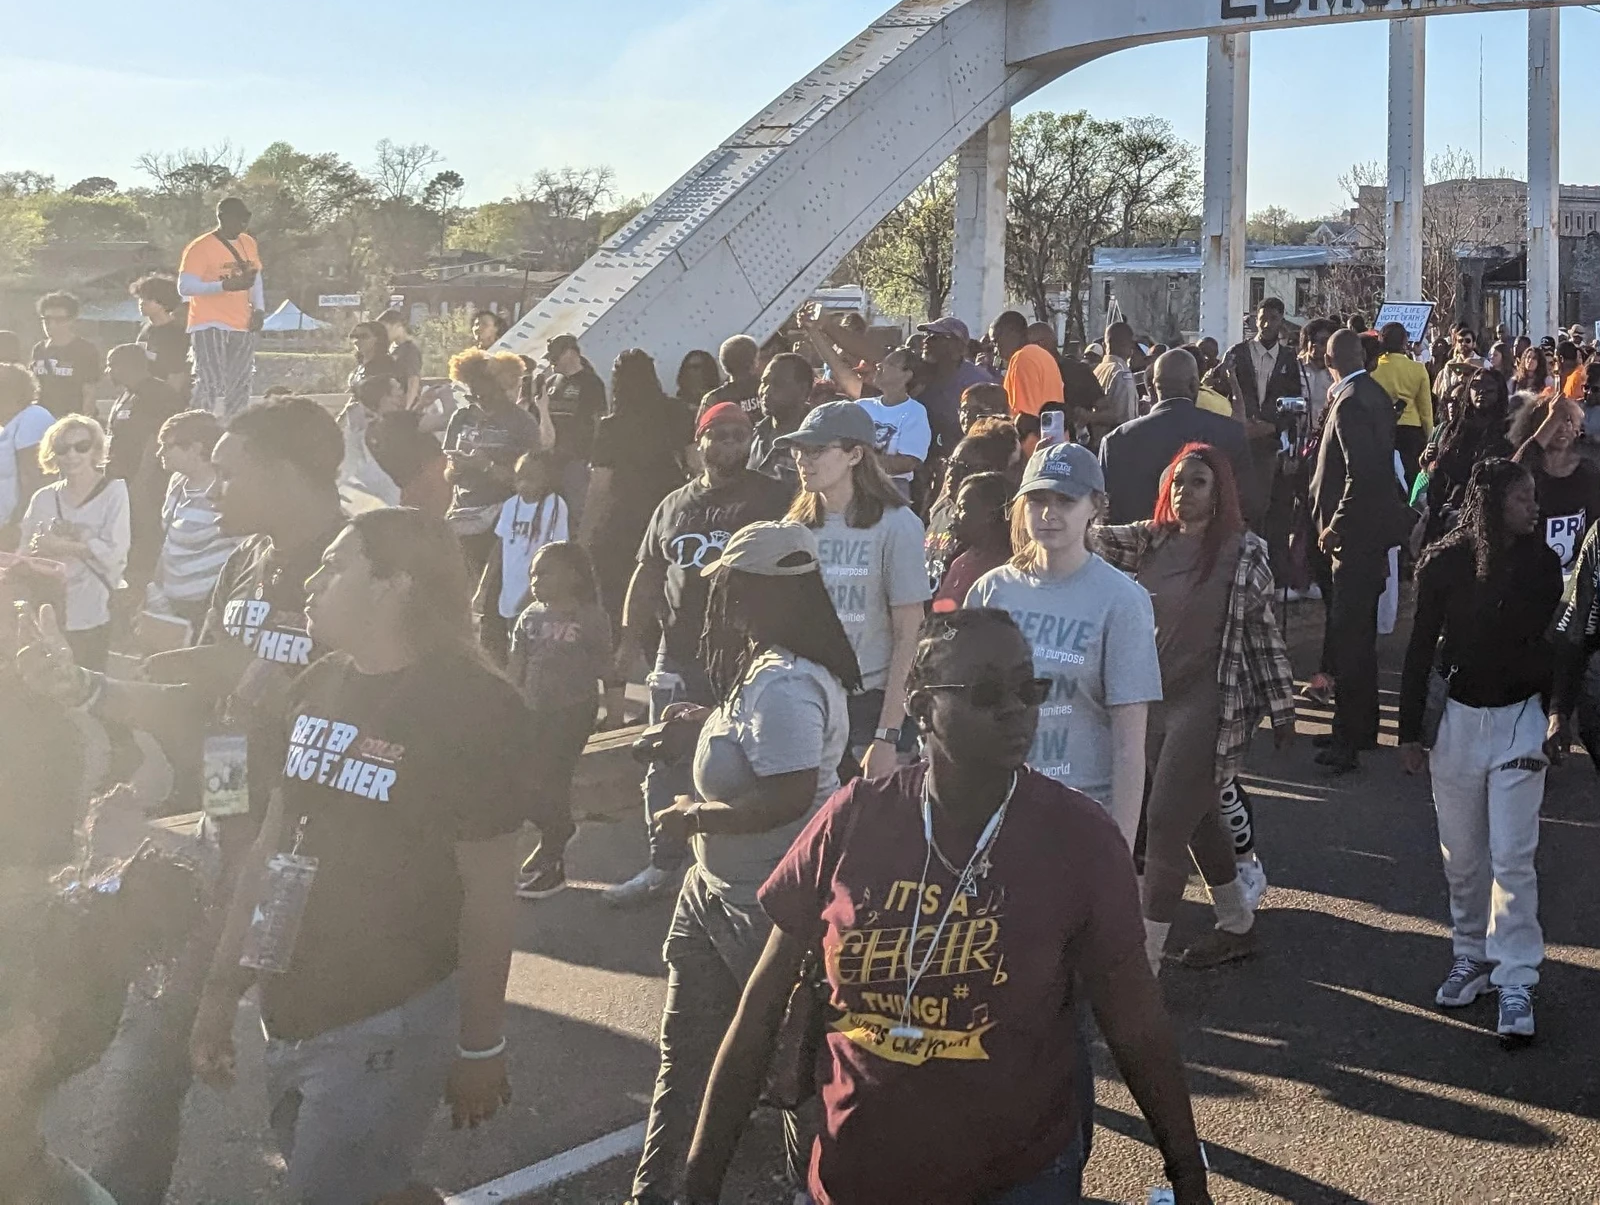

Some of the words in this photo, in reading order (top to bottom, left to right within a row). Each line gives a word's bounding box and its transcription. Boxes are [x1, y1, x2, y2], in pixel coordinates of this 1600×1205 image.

[818, 539, 872, 566] ERVE
[1045, 649, 1085, 665] purpose
[290, 715, 359, 753] BETTER
[282, 745, 397, 802] TOGETHER
[949, 892, 969, 917] A
[836, 917, 999, 985] CHOIR
[861, 991, 949, 1027] THING!
